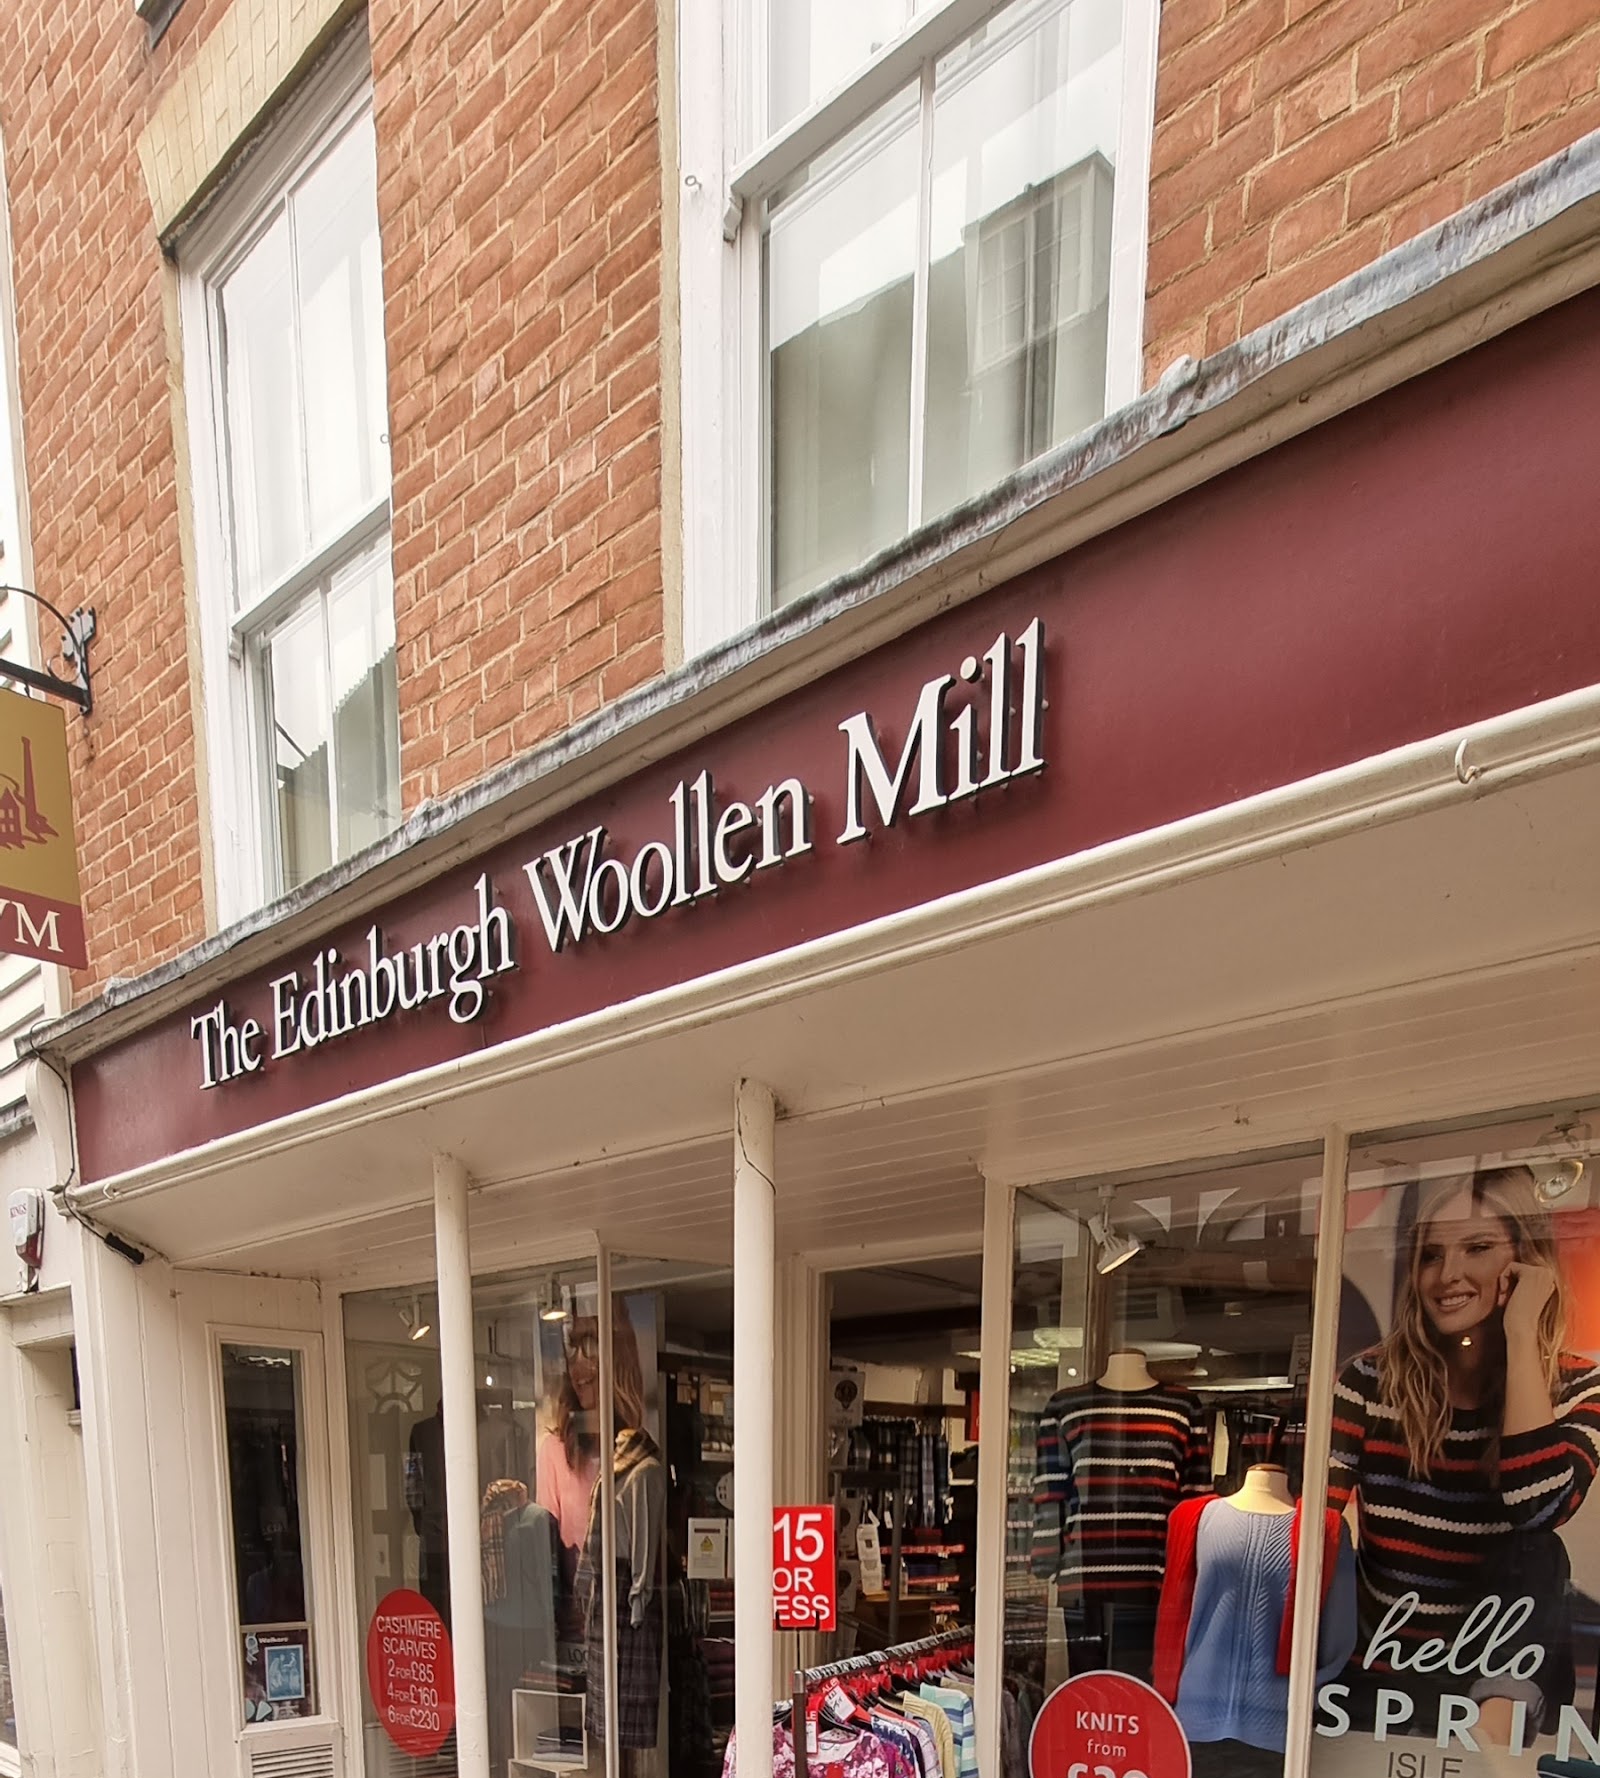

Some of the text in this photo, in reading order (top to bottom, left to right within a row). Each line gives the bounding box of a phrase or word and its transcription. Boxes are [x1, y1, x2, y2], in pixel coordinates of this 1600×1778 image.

[190, 616, 1046, 1090] The Edinburgh Woollen Mill
[772, 1567, 815, 1592] OR
[376, 1615, 442, 1639] CASHMERE
[1362, 1590, 1546, 1680] hello
[382, 1637, 437, 1660] SCARVES
[1076, 1710, 1140, 1735] KNITS
[1087, 1738, 1128, 1758] from
